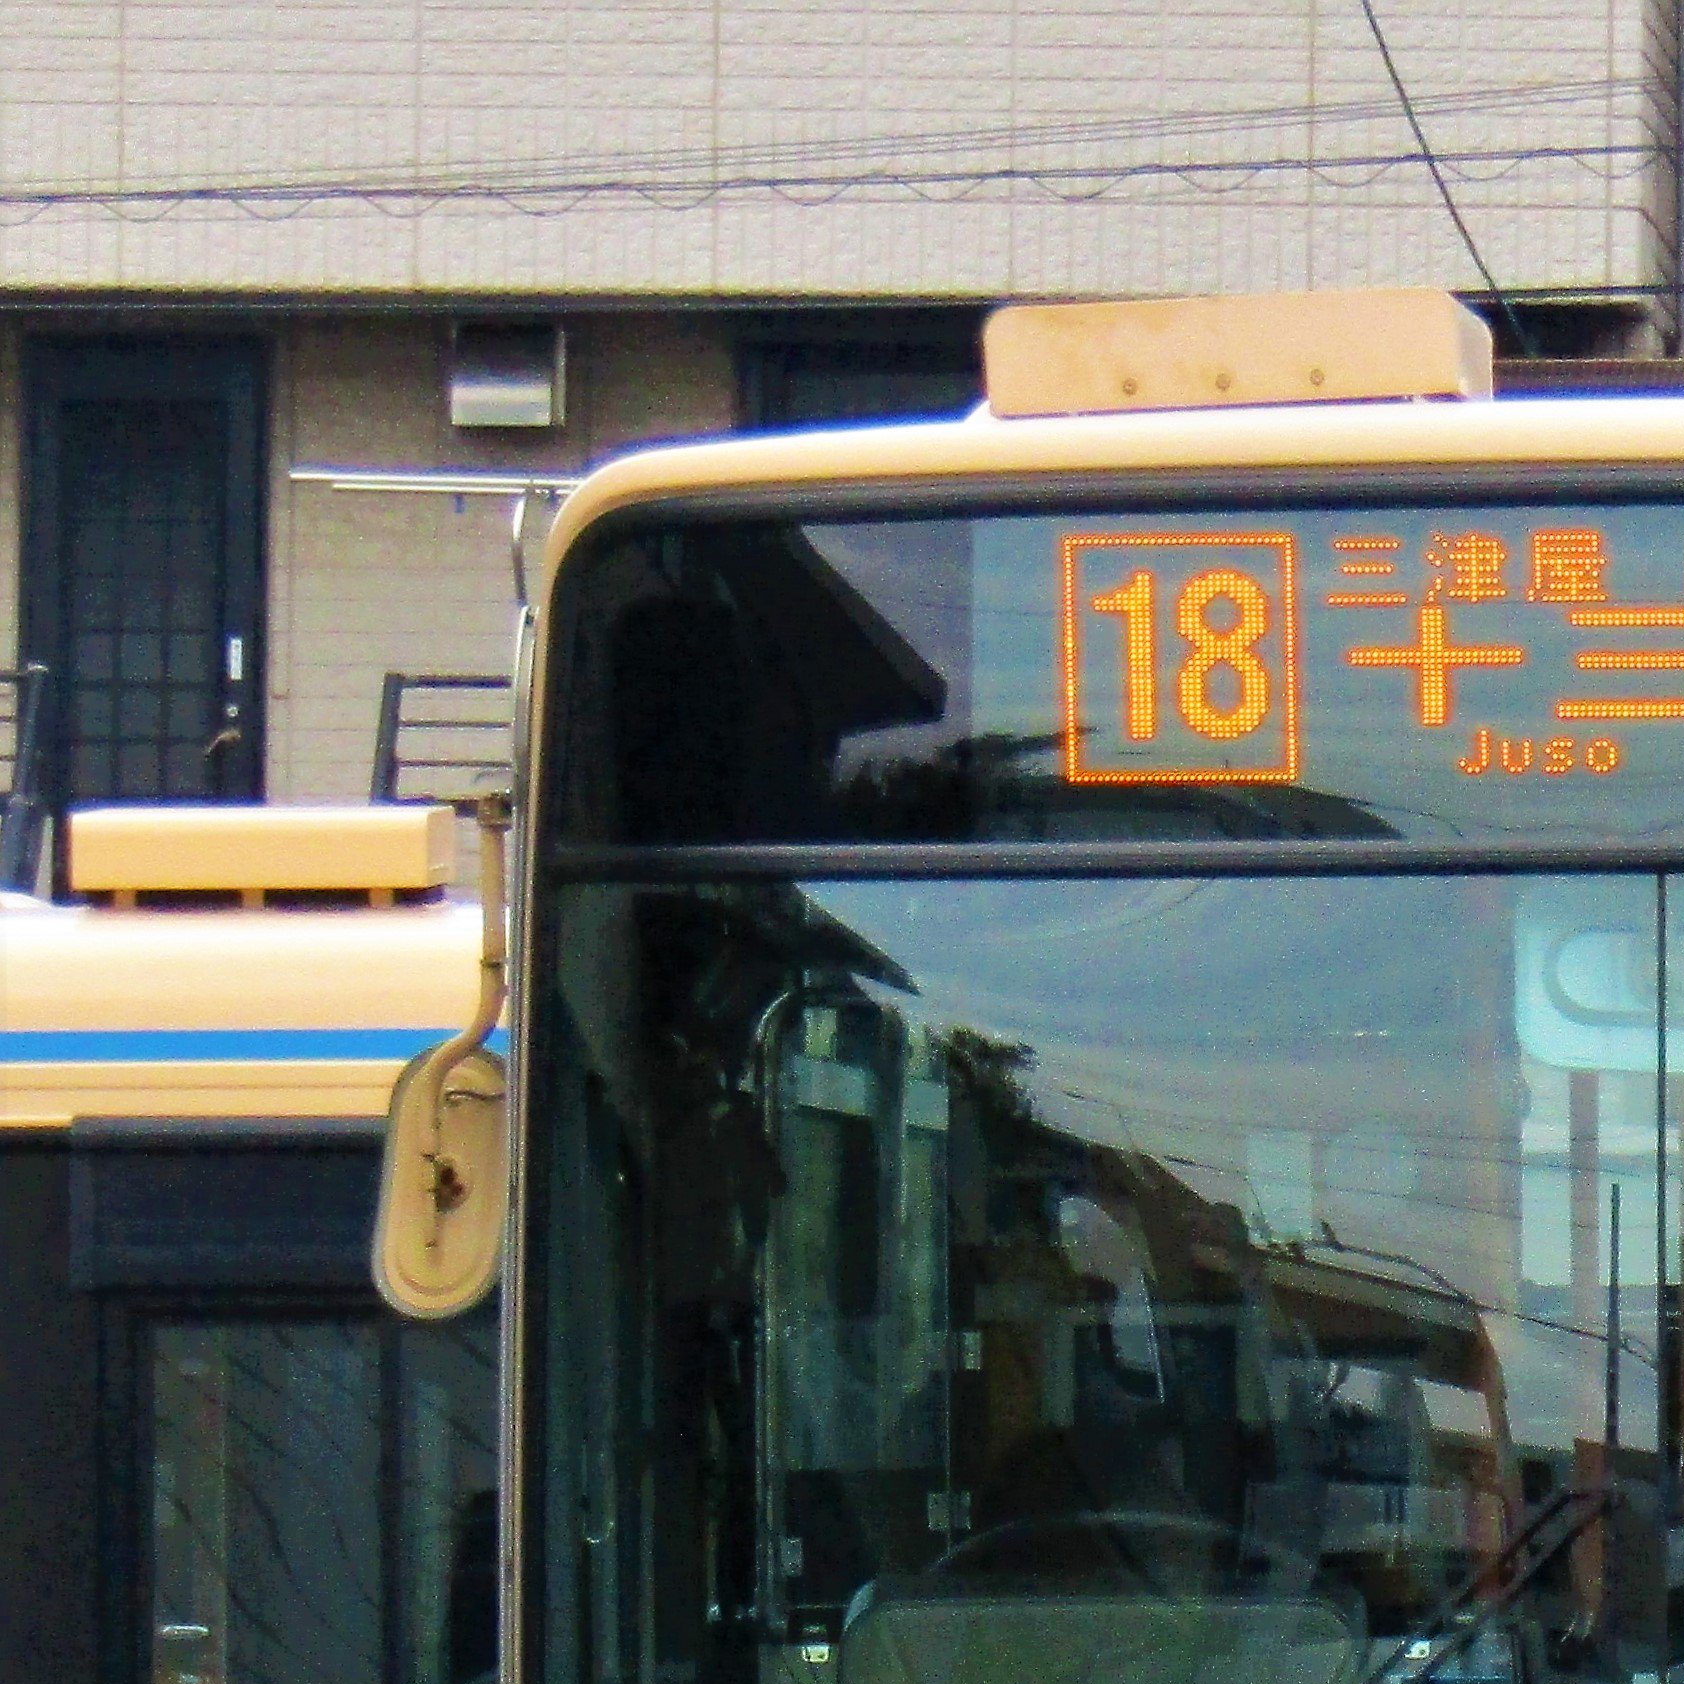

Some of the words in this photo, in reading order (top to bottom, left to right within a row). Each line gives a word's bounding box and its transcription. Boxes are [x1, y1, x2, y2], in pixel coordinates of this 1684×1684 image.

[1326, 530, 1608, 604] 三津屋
[1092, 570, 1270, 740] 18
[1458, 727, 1619, 774] Juso
